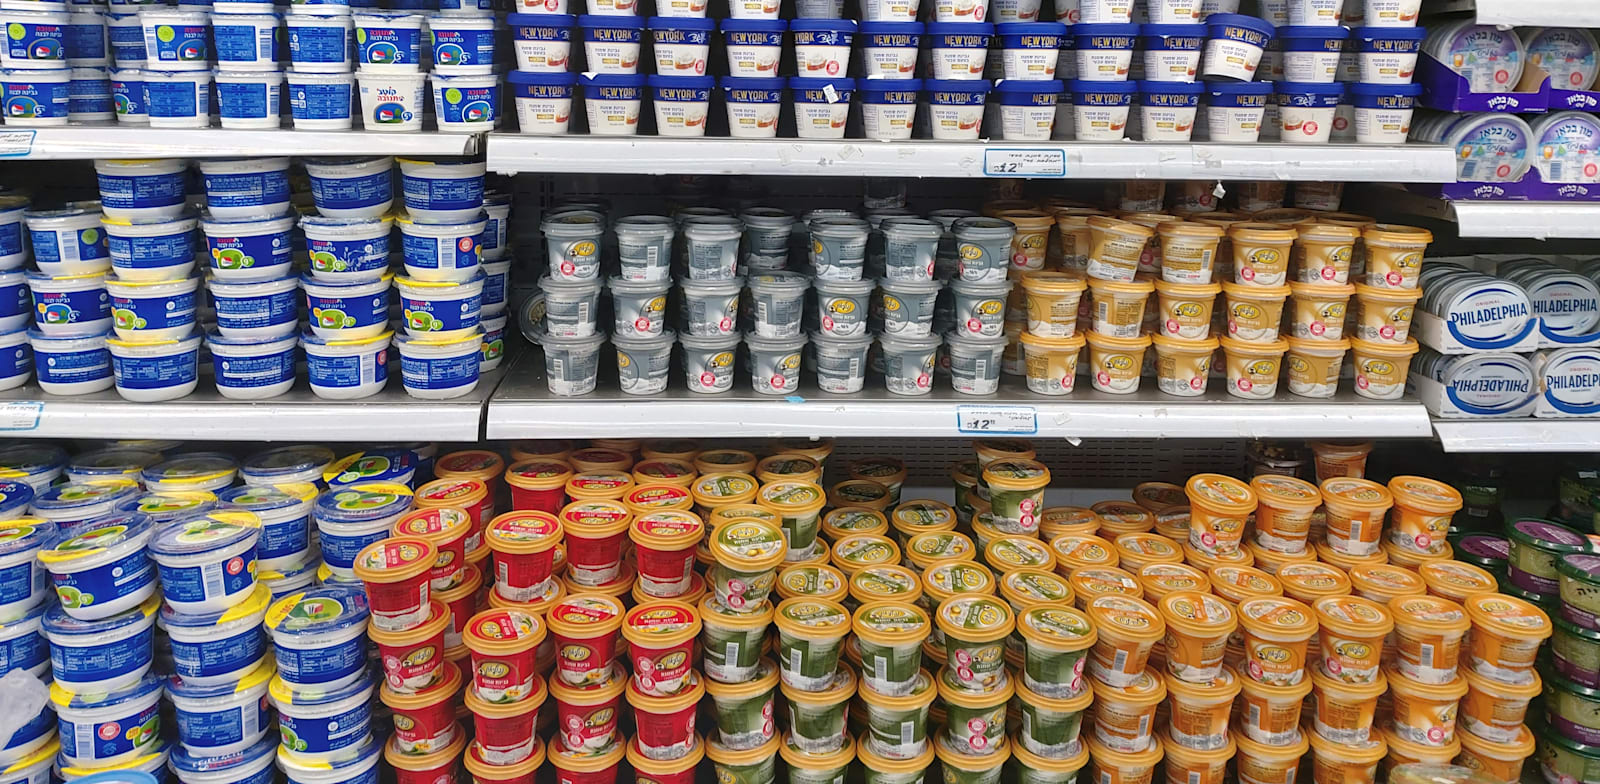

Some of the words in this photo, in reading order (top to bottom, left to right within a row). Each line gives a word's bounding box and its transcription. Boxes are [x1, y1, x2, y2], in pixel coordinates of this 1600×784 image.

[520, 27, 536, 37] NEW
[537, 27, 558, 38] YORK
[594, 29, 611, 39] NEW
[612, 29, 632, 39] YORK
[664, 31, 685, 41] YORK
[731, 33, 746, 42] NEW
[747, 33, 768, 42] YORK
[1225, 27, 1243, 40] NEW
[1243, 31, 1262, 43] YORK
[874, 35, 890, 44] NEW
[891, 35, 910, 44] YORK
[945, 36, 962, 45] NEW
[963, 36, 981, 45] YORK
[1021, 36, 1039, 46] NEW
[1040, 36, 1057, 45] YORK
[1092, 37, 1111, 46] NEW
[1112, 37, 1129, 46] YORK
[1164, 38, 1182, 47] NEW
[1373, 41, 1392, 49] NEW
[1393, 41, 1413, 50] YORK
[528, 86, 546, 95] NEW
[600, 88, 618, 97] NEW
[660, 89, 675, 98] NEW
[676, 89, 696, 98] YORK
[732, 91, 746, 99] NEW
[747, 91, 768, 100] YORK
[885, 92, 899, 101] NEW
[935, 93, 950, 102] NEW
[951, 93, 971, 102] YORK
[1085, 94, 1103, 103] NEW
[1104, 94, 1122, 103] YORK
[1150, 95, 1168, 104] NEW
[1169, 95, 1188, 104] YORK
[1377, 97, 1398, 105] NEW
[1567, 94, 1585, 106] בלאן
[1586, 95, 1598, 107] מון
[1488, 96, 1506, 108] בלאן
[1507, 97, 1519, 108] מון
[1480, 127, 1503, 139] בלאן
[1503, 128, 1517, 140] מון
[1556, 125, 1577, 137] בלאן
[1579, 126, 1593, 138] מון
[1533, 298, 1597, 313] HILADELPHIA
[1450, 303, 1528, 326] PHILADELPHIA
[1453, 379, 1529, 393] PHILADELPHIA
